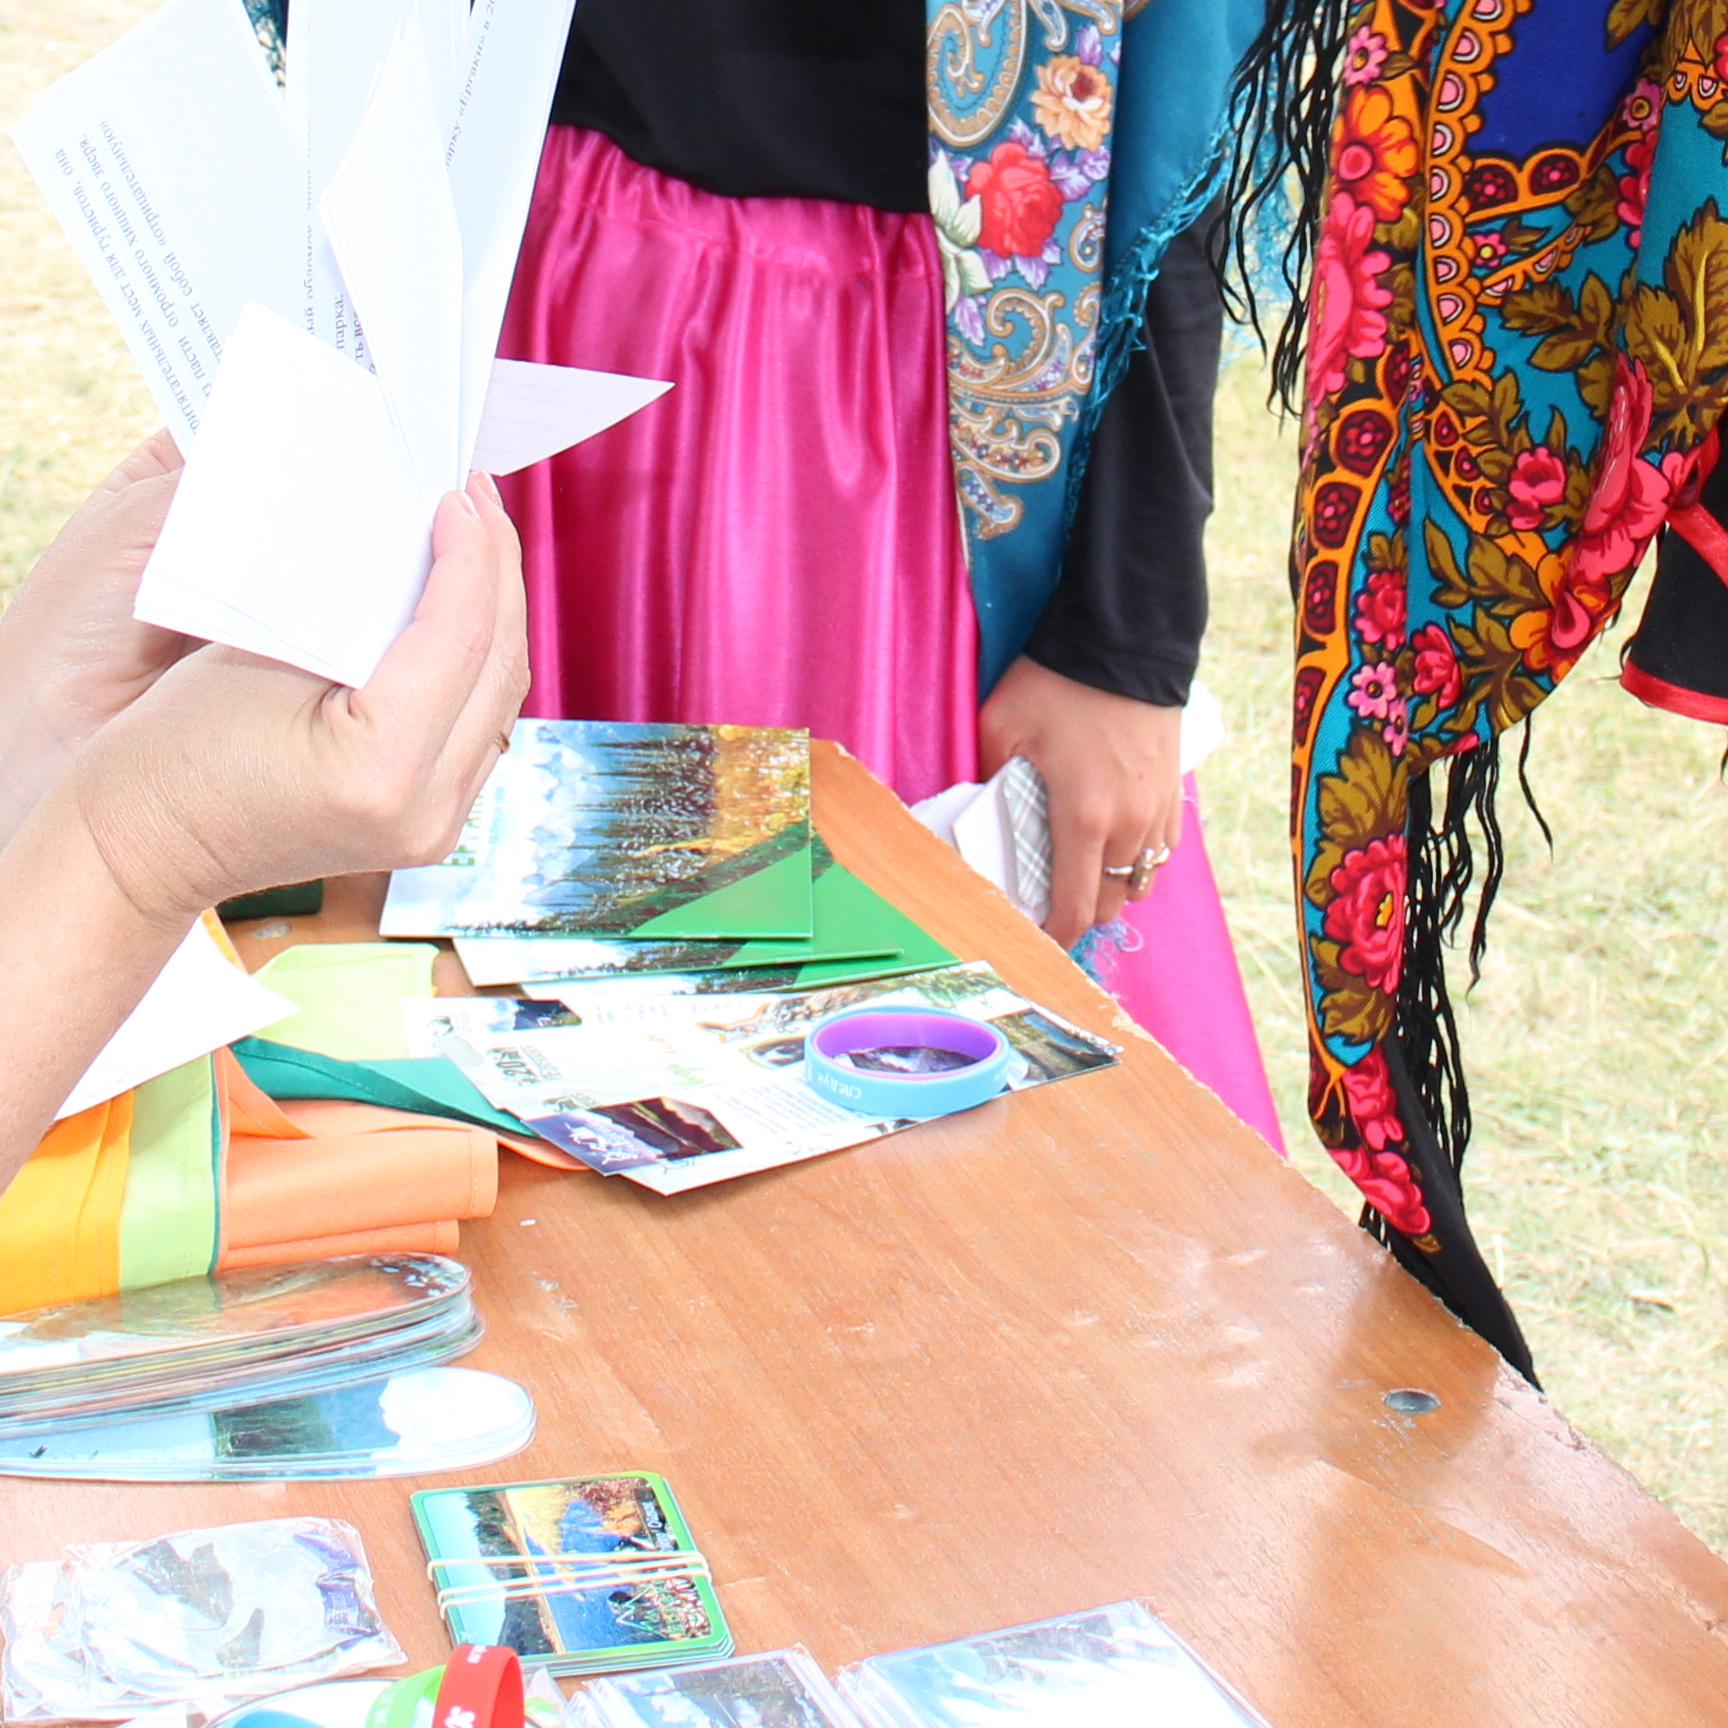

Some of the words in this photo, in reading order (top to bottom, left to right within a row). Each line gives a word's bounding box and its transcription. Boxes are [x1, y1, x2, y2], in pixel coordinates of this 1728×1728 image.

[53, 147, 75, 177] она
[76, 134, 106, 179] зверя.
[98, 119, 168, 248] «отрицательную»
[70, 179, 112, 253] туристов,
[99, 180, 138, 247] хищного
[104, 252, 127, 280] для
[133, 248, 180, 328] огромного
[162, 251, 194, 298] собой
[118, 282, 144, 318] мест
[334, 293, 348, 350] парка:
[177, 335, 206, 380] пасти
[187, 300, 225, 364] тавляет
[138, 319, 201, 434] ритягательных
